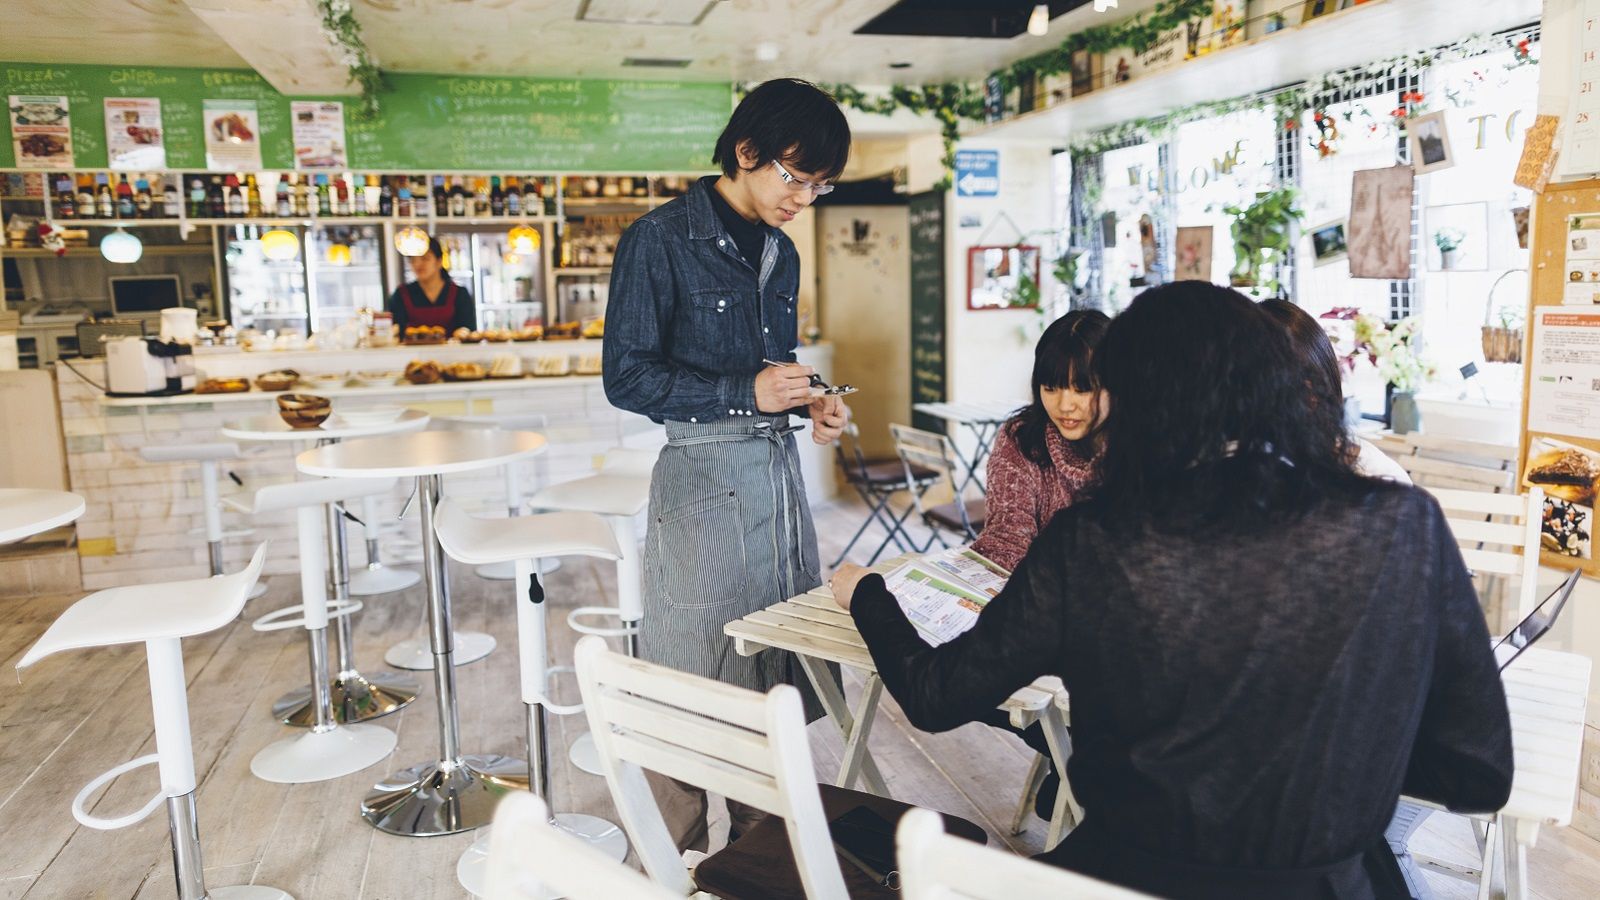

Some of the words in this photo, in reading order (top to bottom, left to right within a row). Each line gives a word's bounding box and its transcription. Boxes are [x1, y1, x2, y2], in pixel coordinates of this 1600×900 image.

[1586, 19, 1593, 31] 7
[1584, 50, 1595, 62] 14
[1580, 82, 1592, 93] 21
[1576, 112, 1589, 124] 28
